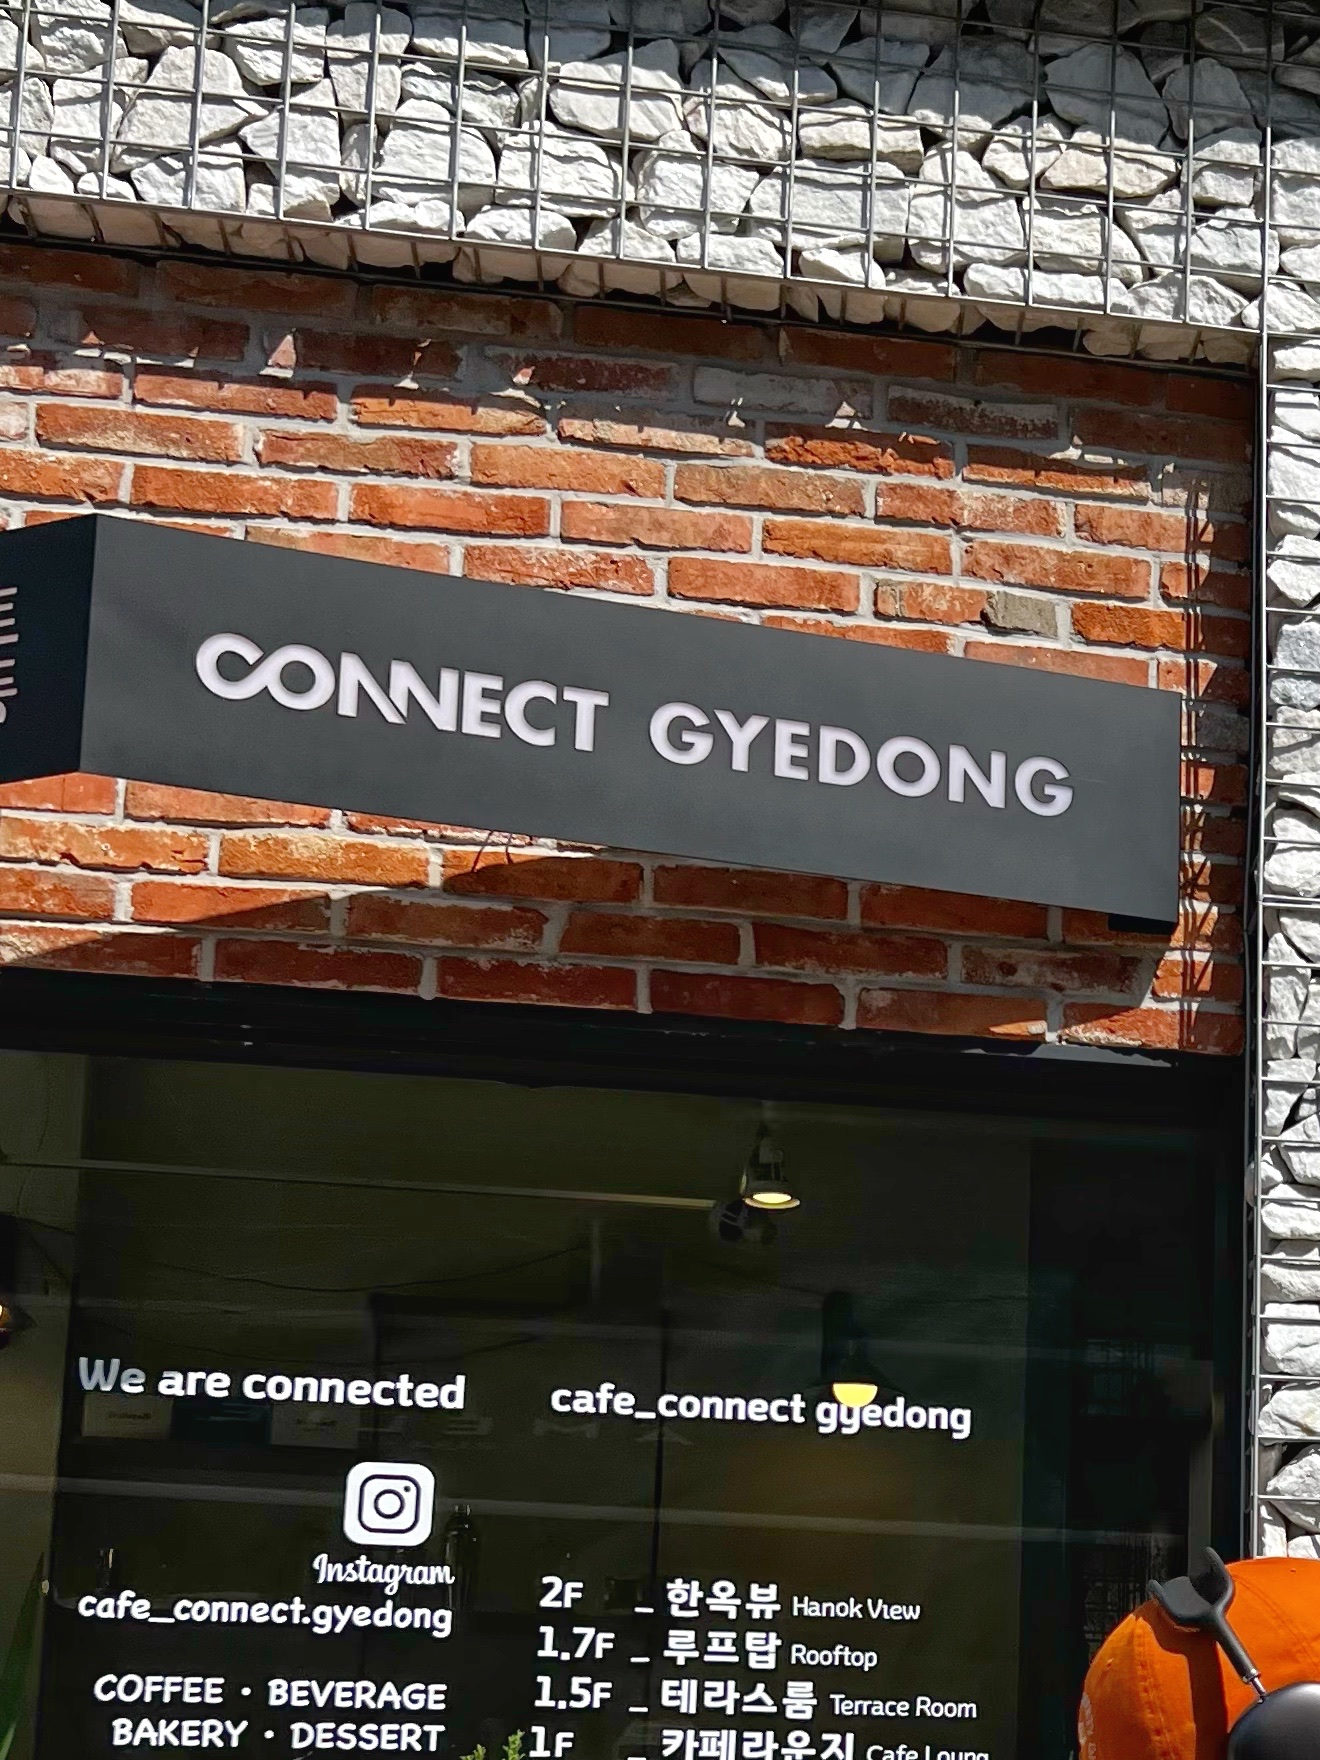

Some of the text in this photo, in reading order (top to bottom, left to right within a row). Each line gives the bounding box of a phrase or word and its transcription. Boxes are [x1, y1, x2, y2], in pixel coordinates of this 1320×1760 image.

[196, 632, 1076, 818] CONNECT GYEDONG
[78, 1356, 466, 1410] We are connected
[550, 1381, 972, 1440] cafe_connect gyedong
[312, 1553, 456, 1596] Instagram
[77, 1589, 453, 1639] cafe_connect.gyedong
[538, 1575, 584, 1609] 2F
[665, 1577, 782, 1621] 한옥뷰
[792, 1595, 863, 1619] Hanok
[866, 1597, 922, 1620] View
[536, 1625, 616, 1661] 1.7F
[662, 1628, 782, 1671] 루프탑
[790, 1643, 878, 1672] Rooftop
[93, 1673, 226, 1704] COFFEE
[267, 1678, 448, 1711] BEVERAGE
[533, 1675, 614, 1710] 1.5F
[661, 1678, 818, 1721] 테라스룸
[829, 1692, 910, 1717] Terrace
[915, 1696, 978, 1719] Room
[111, 1717, 249, 1749] BAKERY
[289, 1721, 446, 1752] DESSERT
[528, 1725, 574, 1759] 1F
